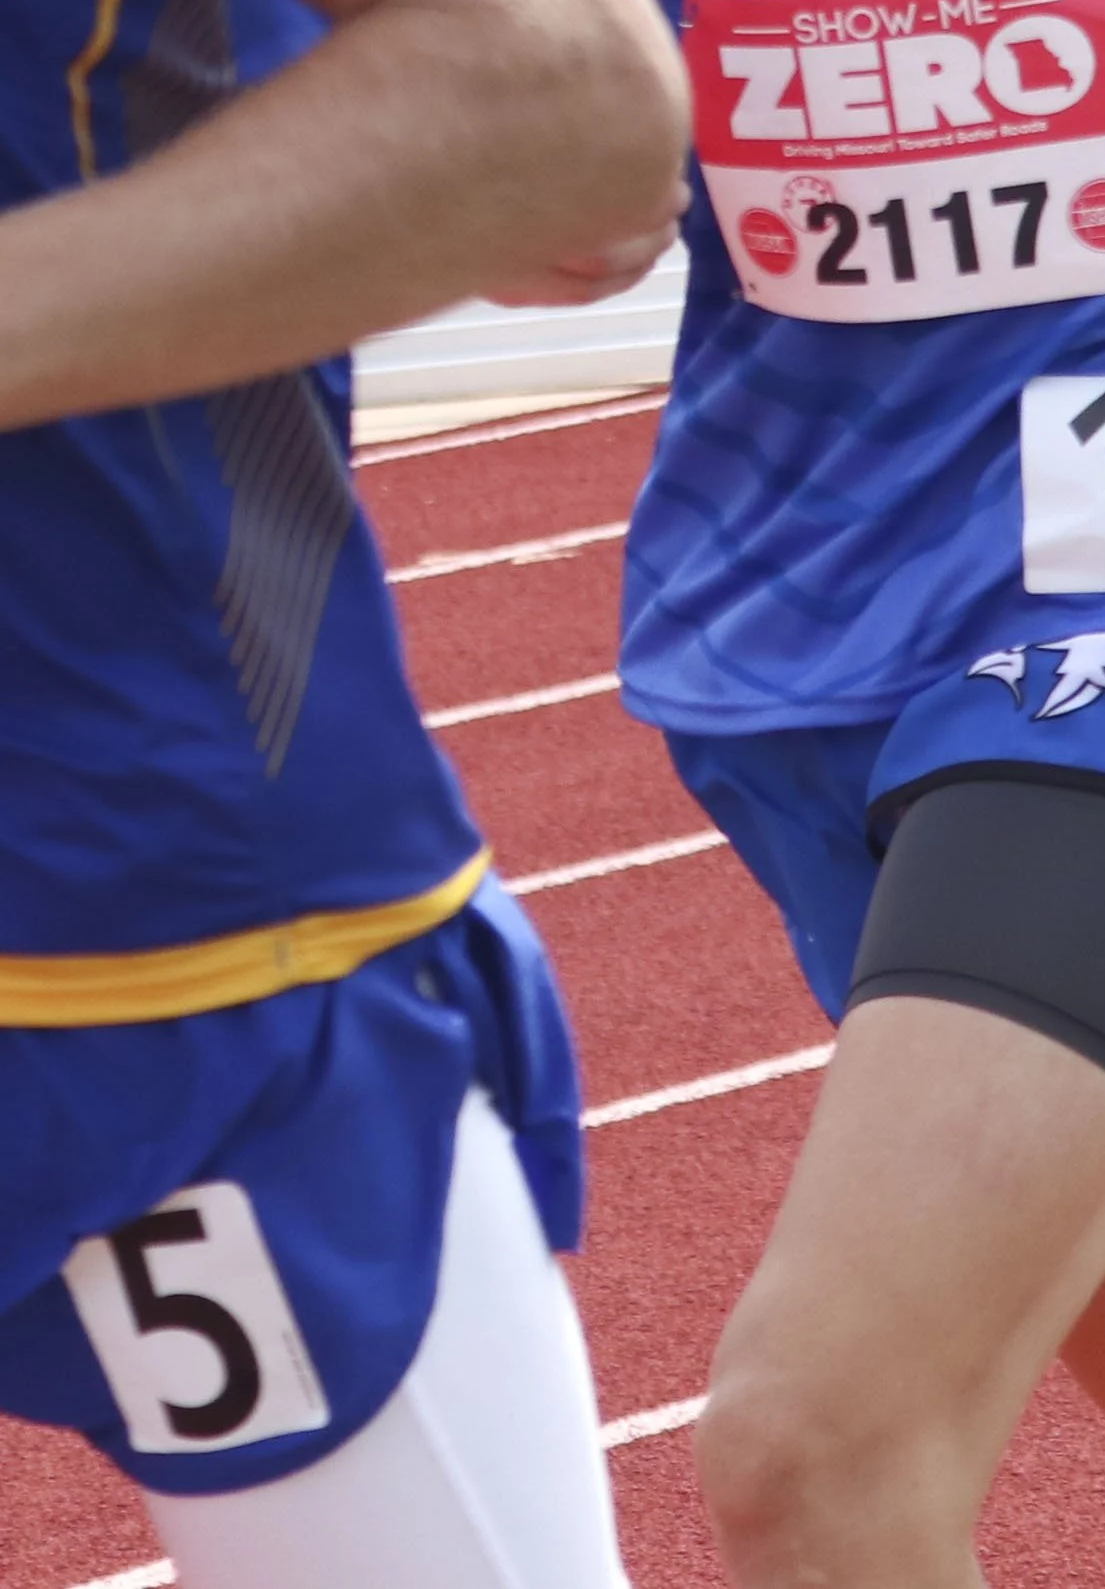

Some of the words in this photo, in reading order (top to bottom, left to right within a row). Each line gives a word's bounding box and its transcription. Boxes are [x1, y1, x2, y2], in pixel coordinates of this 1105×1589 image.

[718, 16, 1096, 140] ZERO
[782, 141, 834, 160] Driving
[836, 133, 895, 156] Missouri
[897, 134, 953, 151] Toward
[1000, 121, 1048, 138] Roads
[806, 181, 1048, 286] 2117
[107, 1209, 260, 1440] 5
